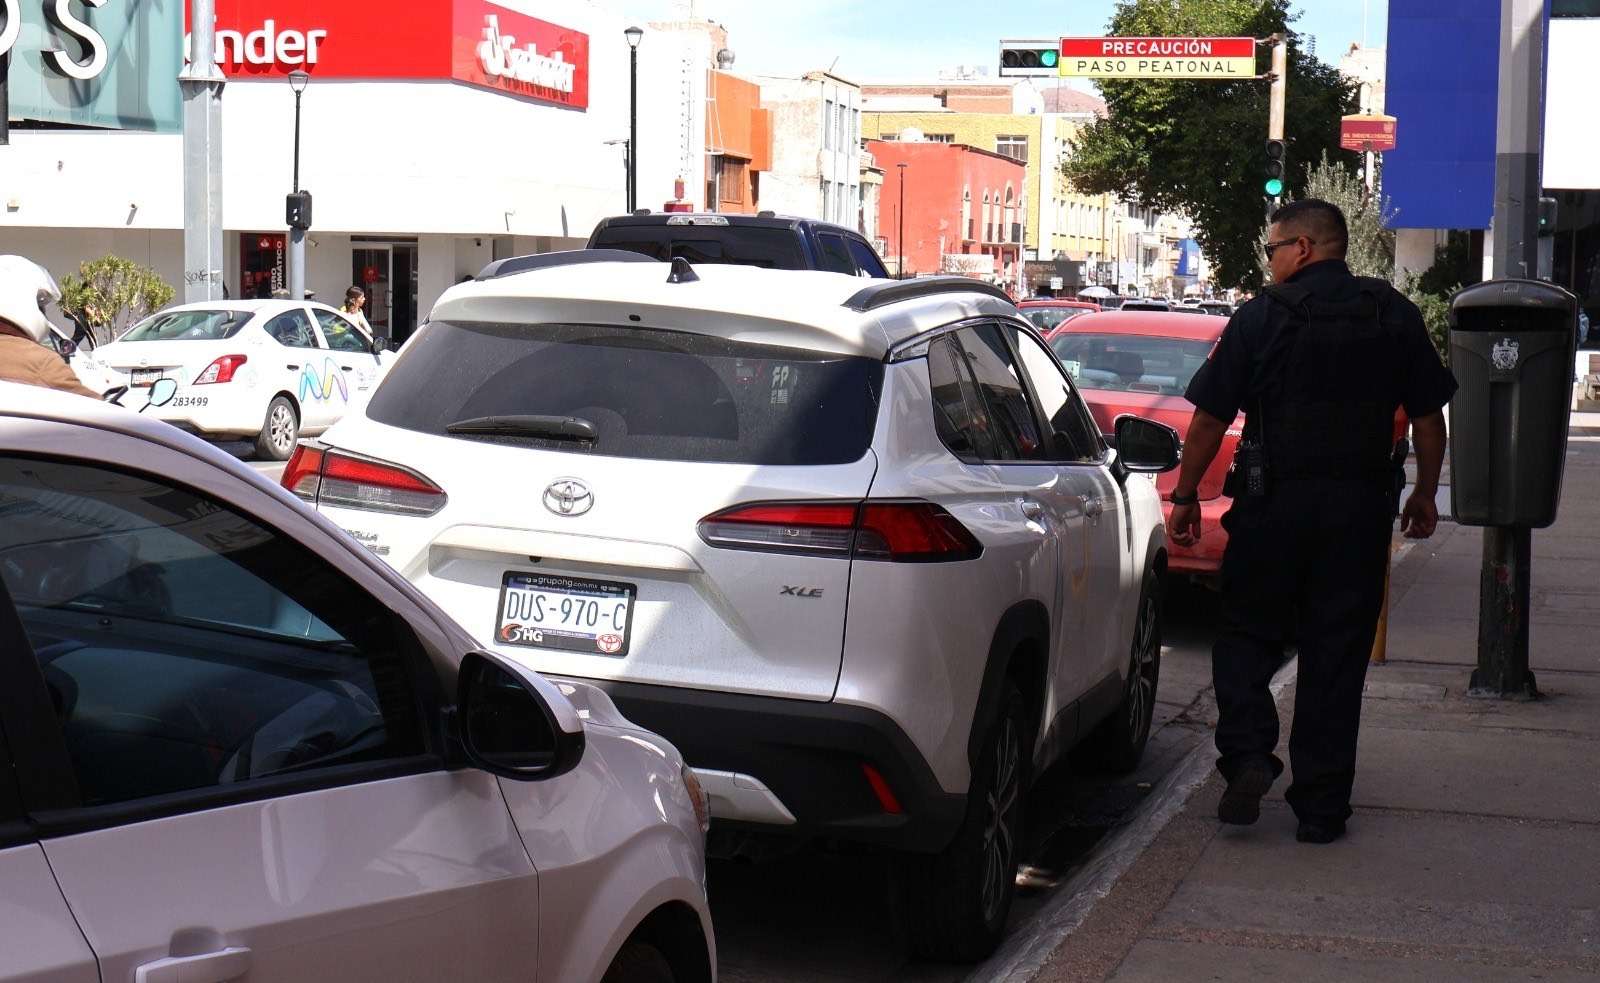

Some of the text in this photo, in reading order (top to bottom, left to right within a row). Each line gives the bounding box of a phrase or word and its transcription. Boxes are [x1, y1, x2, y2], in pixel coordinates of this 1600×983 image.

[184, 18, 327, 65] nder
[1102, 39, 1212, 55] PRECAUCIÓN
[1077, 60, 1236, 73] PASO PEATONAL
[172, 397, 209, 407] 283499
[780, 585, 825, 598] XLE
[506, 591, 626, 631] DUS-970-C
